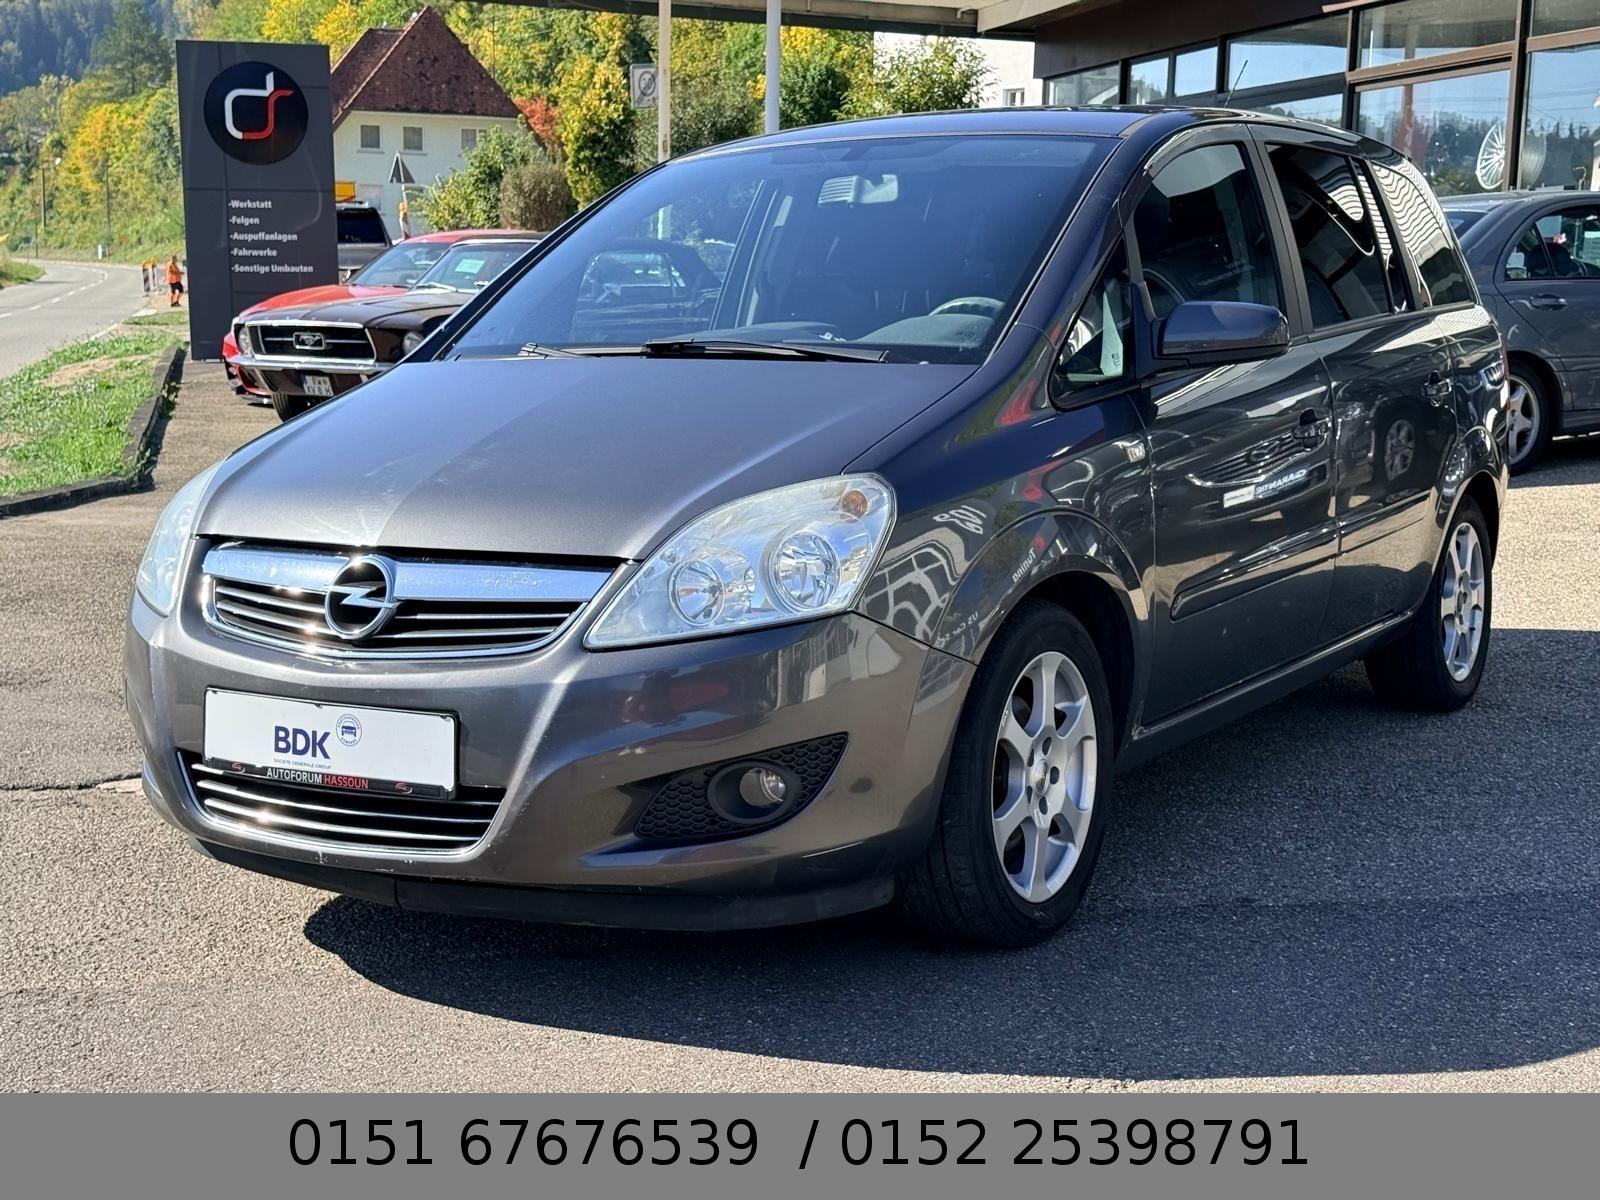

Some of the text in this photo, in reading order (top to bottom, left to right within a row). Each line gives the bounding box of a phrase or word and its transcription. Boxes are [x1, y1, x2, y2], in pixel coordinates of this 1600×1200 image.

[228, 200, 272, 209] -Werkstatt
[229, 216, 260, 226] -Felgen
[230, 232, 298, 243] -Auspuffanlagen
[230, 248, 277, 256] -Fahrwerke
[271, 264, 314, 273] Umbauten
[274, 725, 331, 760] BDK
[266, 767, 369, 789] AUTOFORUM HASSOUN
